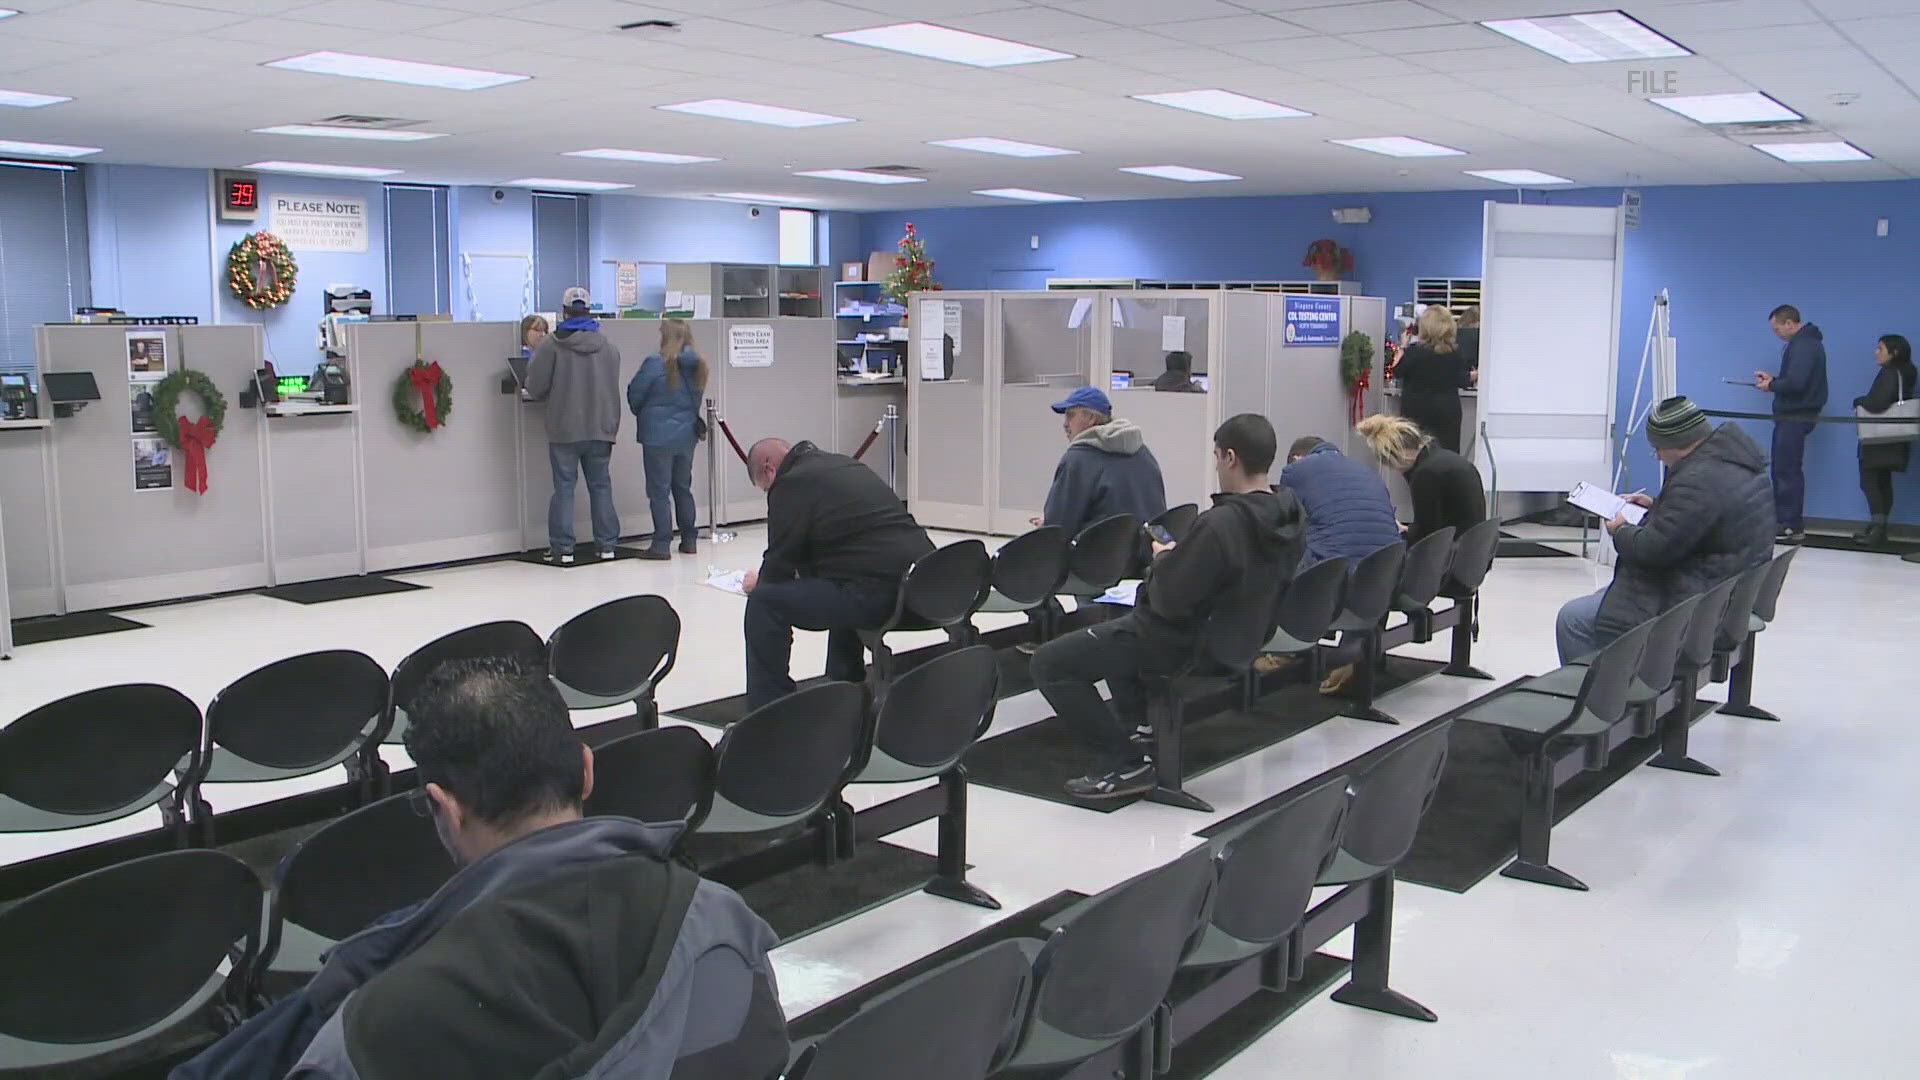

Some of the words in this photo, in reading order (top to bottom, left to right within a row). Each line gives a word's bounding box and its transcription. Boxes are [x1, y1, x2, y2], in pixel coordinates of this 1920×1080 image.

[231, 183, 254, 206] 39
[277, 199, 323, 213] PLEASE
[326, 201, 360, 215] NOTE:
[1298, 311, 1319, 321] TESTING
[1319, 312, 1337, 322] CENTER
